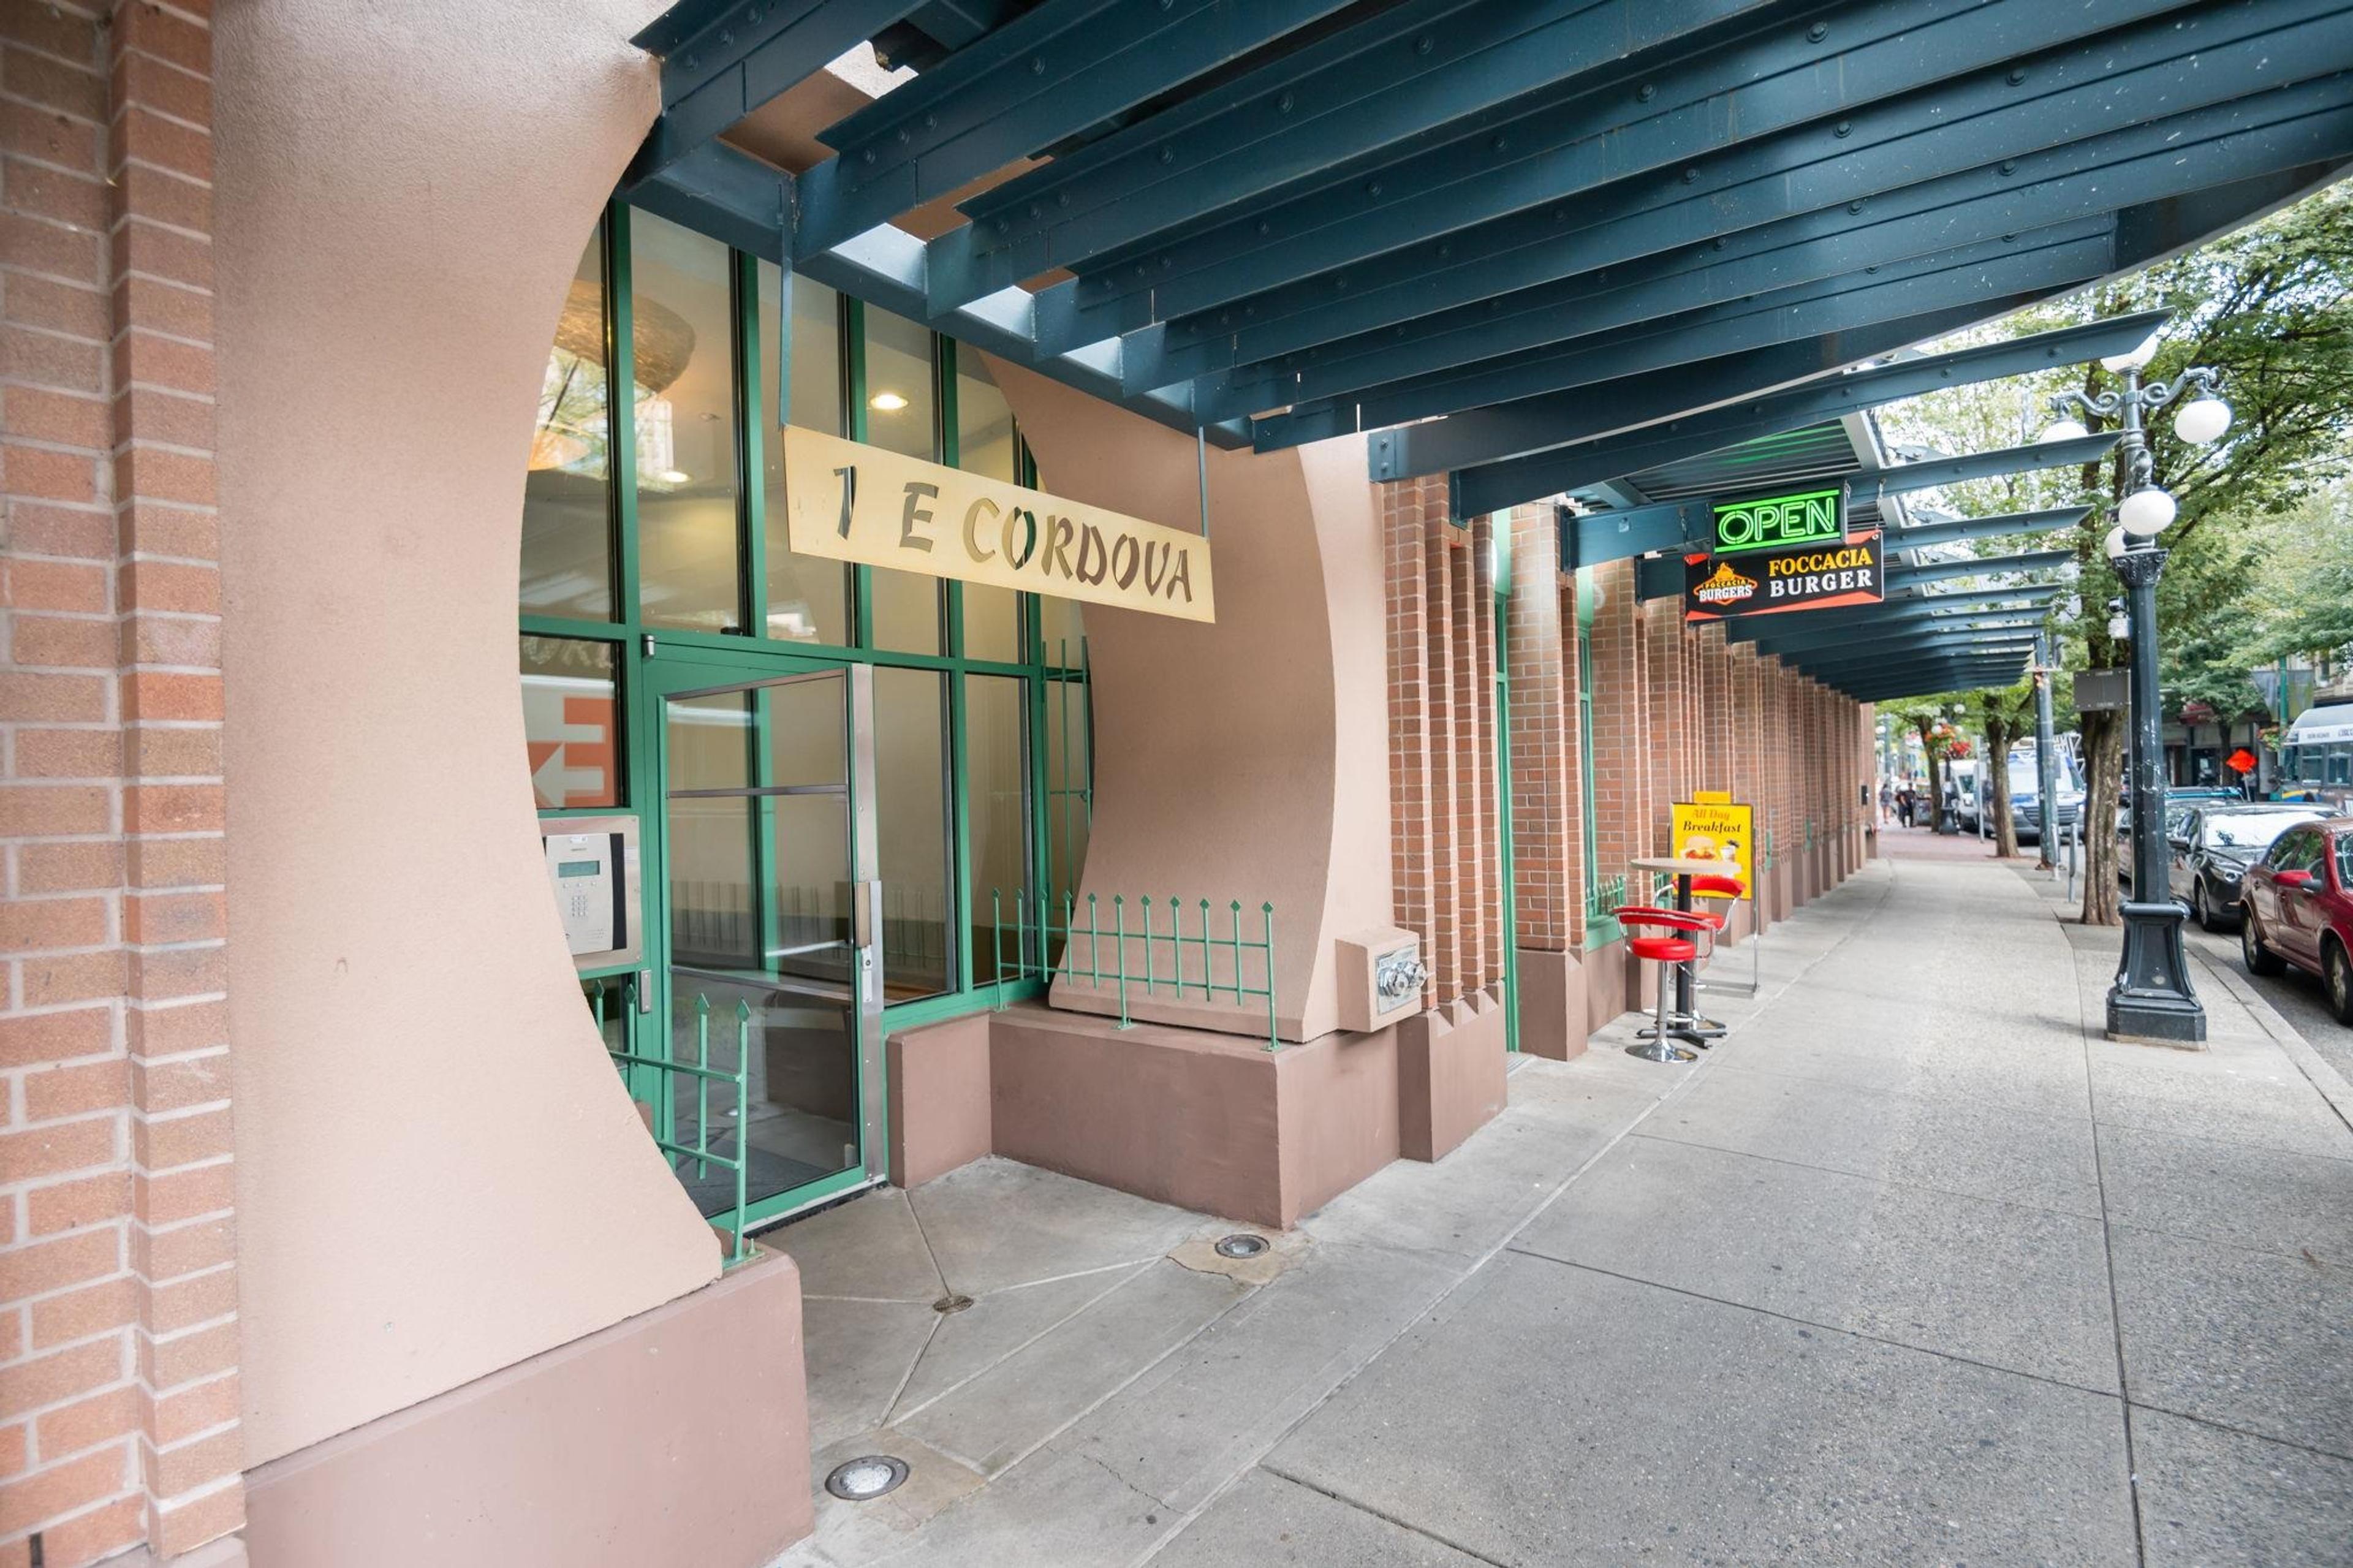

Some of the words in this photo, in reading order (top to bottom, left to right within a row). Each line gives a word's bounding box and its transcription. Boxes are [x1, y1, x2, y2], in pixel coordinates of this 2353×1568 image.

[1718, 496, 1835, 545] OPEN
[898, 481, 940, 553] E
[963, 497, 1192, 604] CORDOVA
[1768, 548, 1873, 577] FOCCACIA
[1699, 585, 1752, 602] BURGERS
[1705, 579, 1747, 588] FOCCACIA
[1770, 569, 1873, 597] BURGER
[1692, 809, 1707, 818] All
[1710, 809, 1730, 821] Day
[1683, 820, 1741, 833] Breakfast
